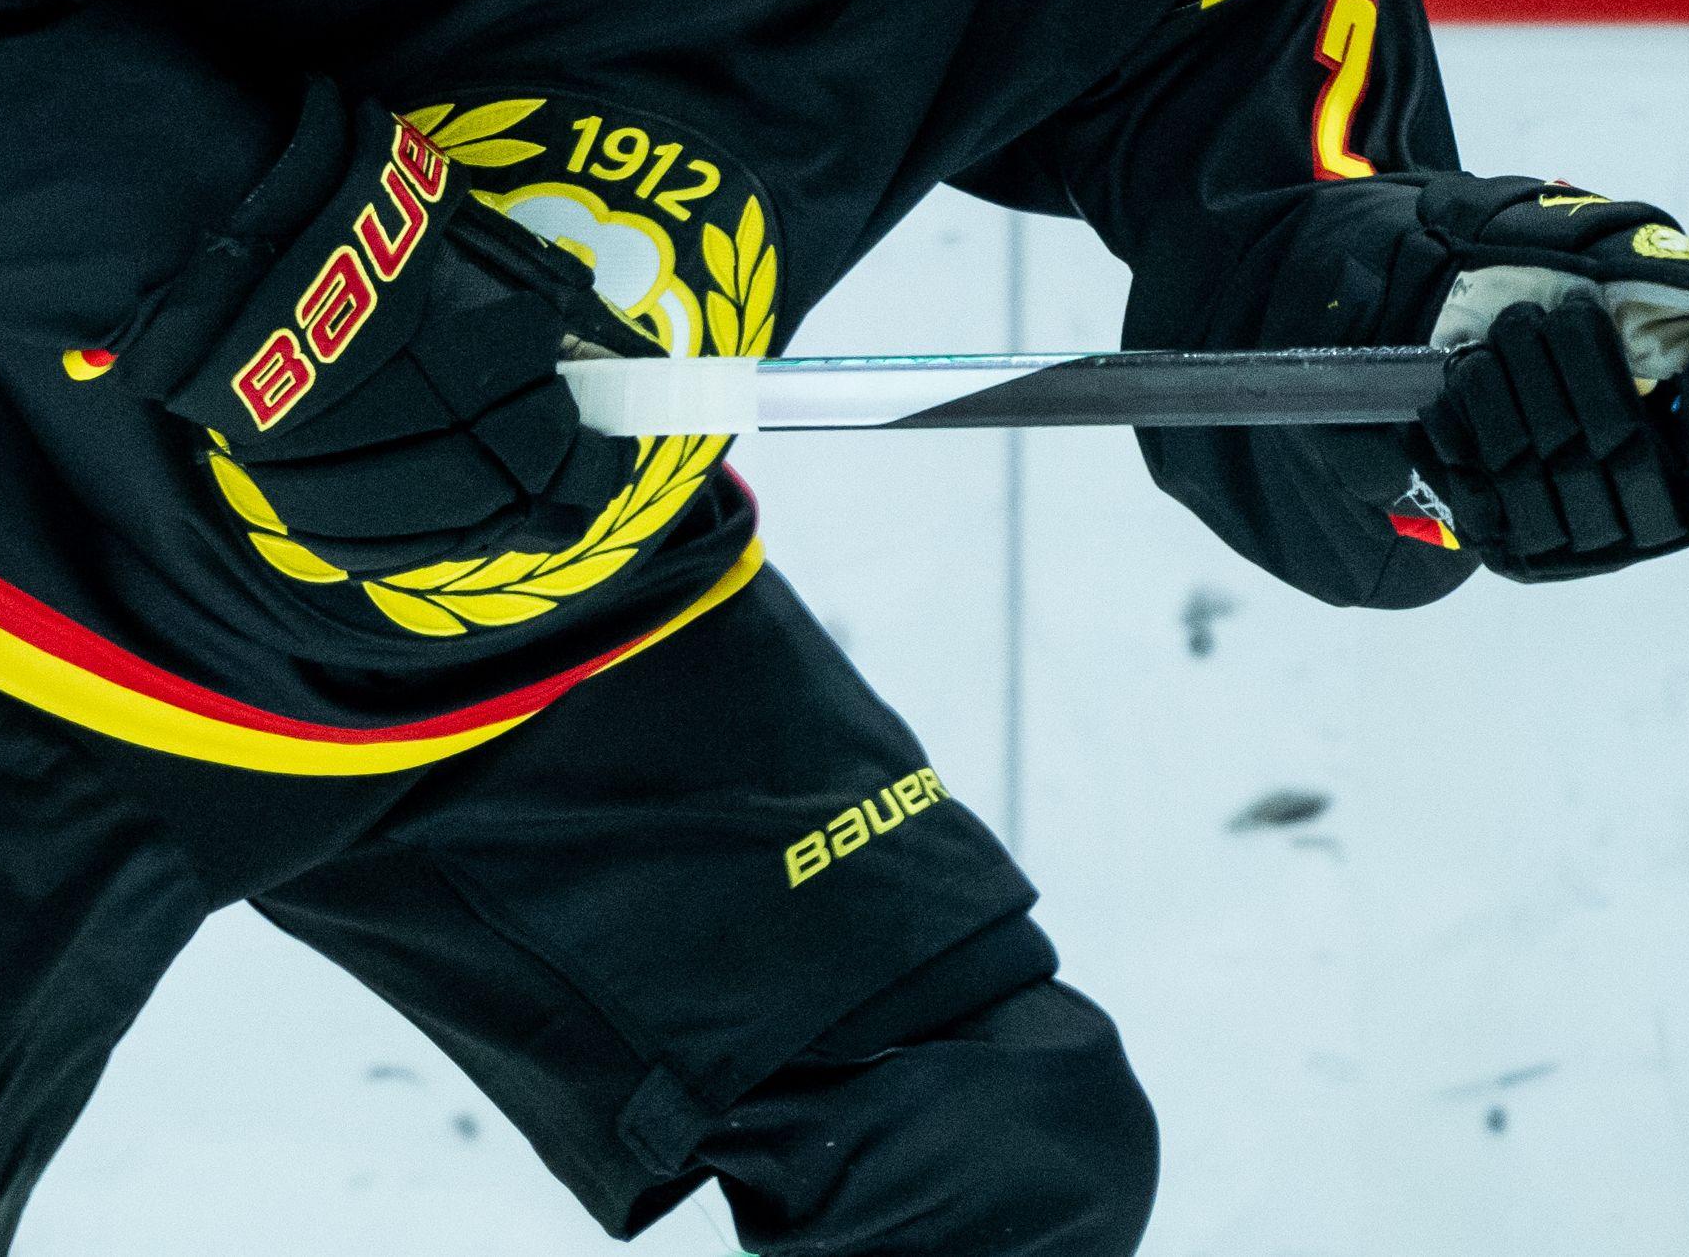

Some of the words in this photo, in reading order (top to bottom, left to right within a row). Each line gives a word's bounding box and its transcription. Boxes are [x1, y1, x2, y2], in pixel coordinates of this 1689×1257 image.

[565, 114, 722, 222] 1912
[231, 113, 449, 431] BAUE
[784, 765, 952, 889] BAUER
